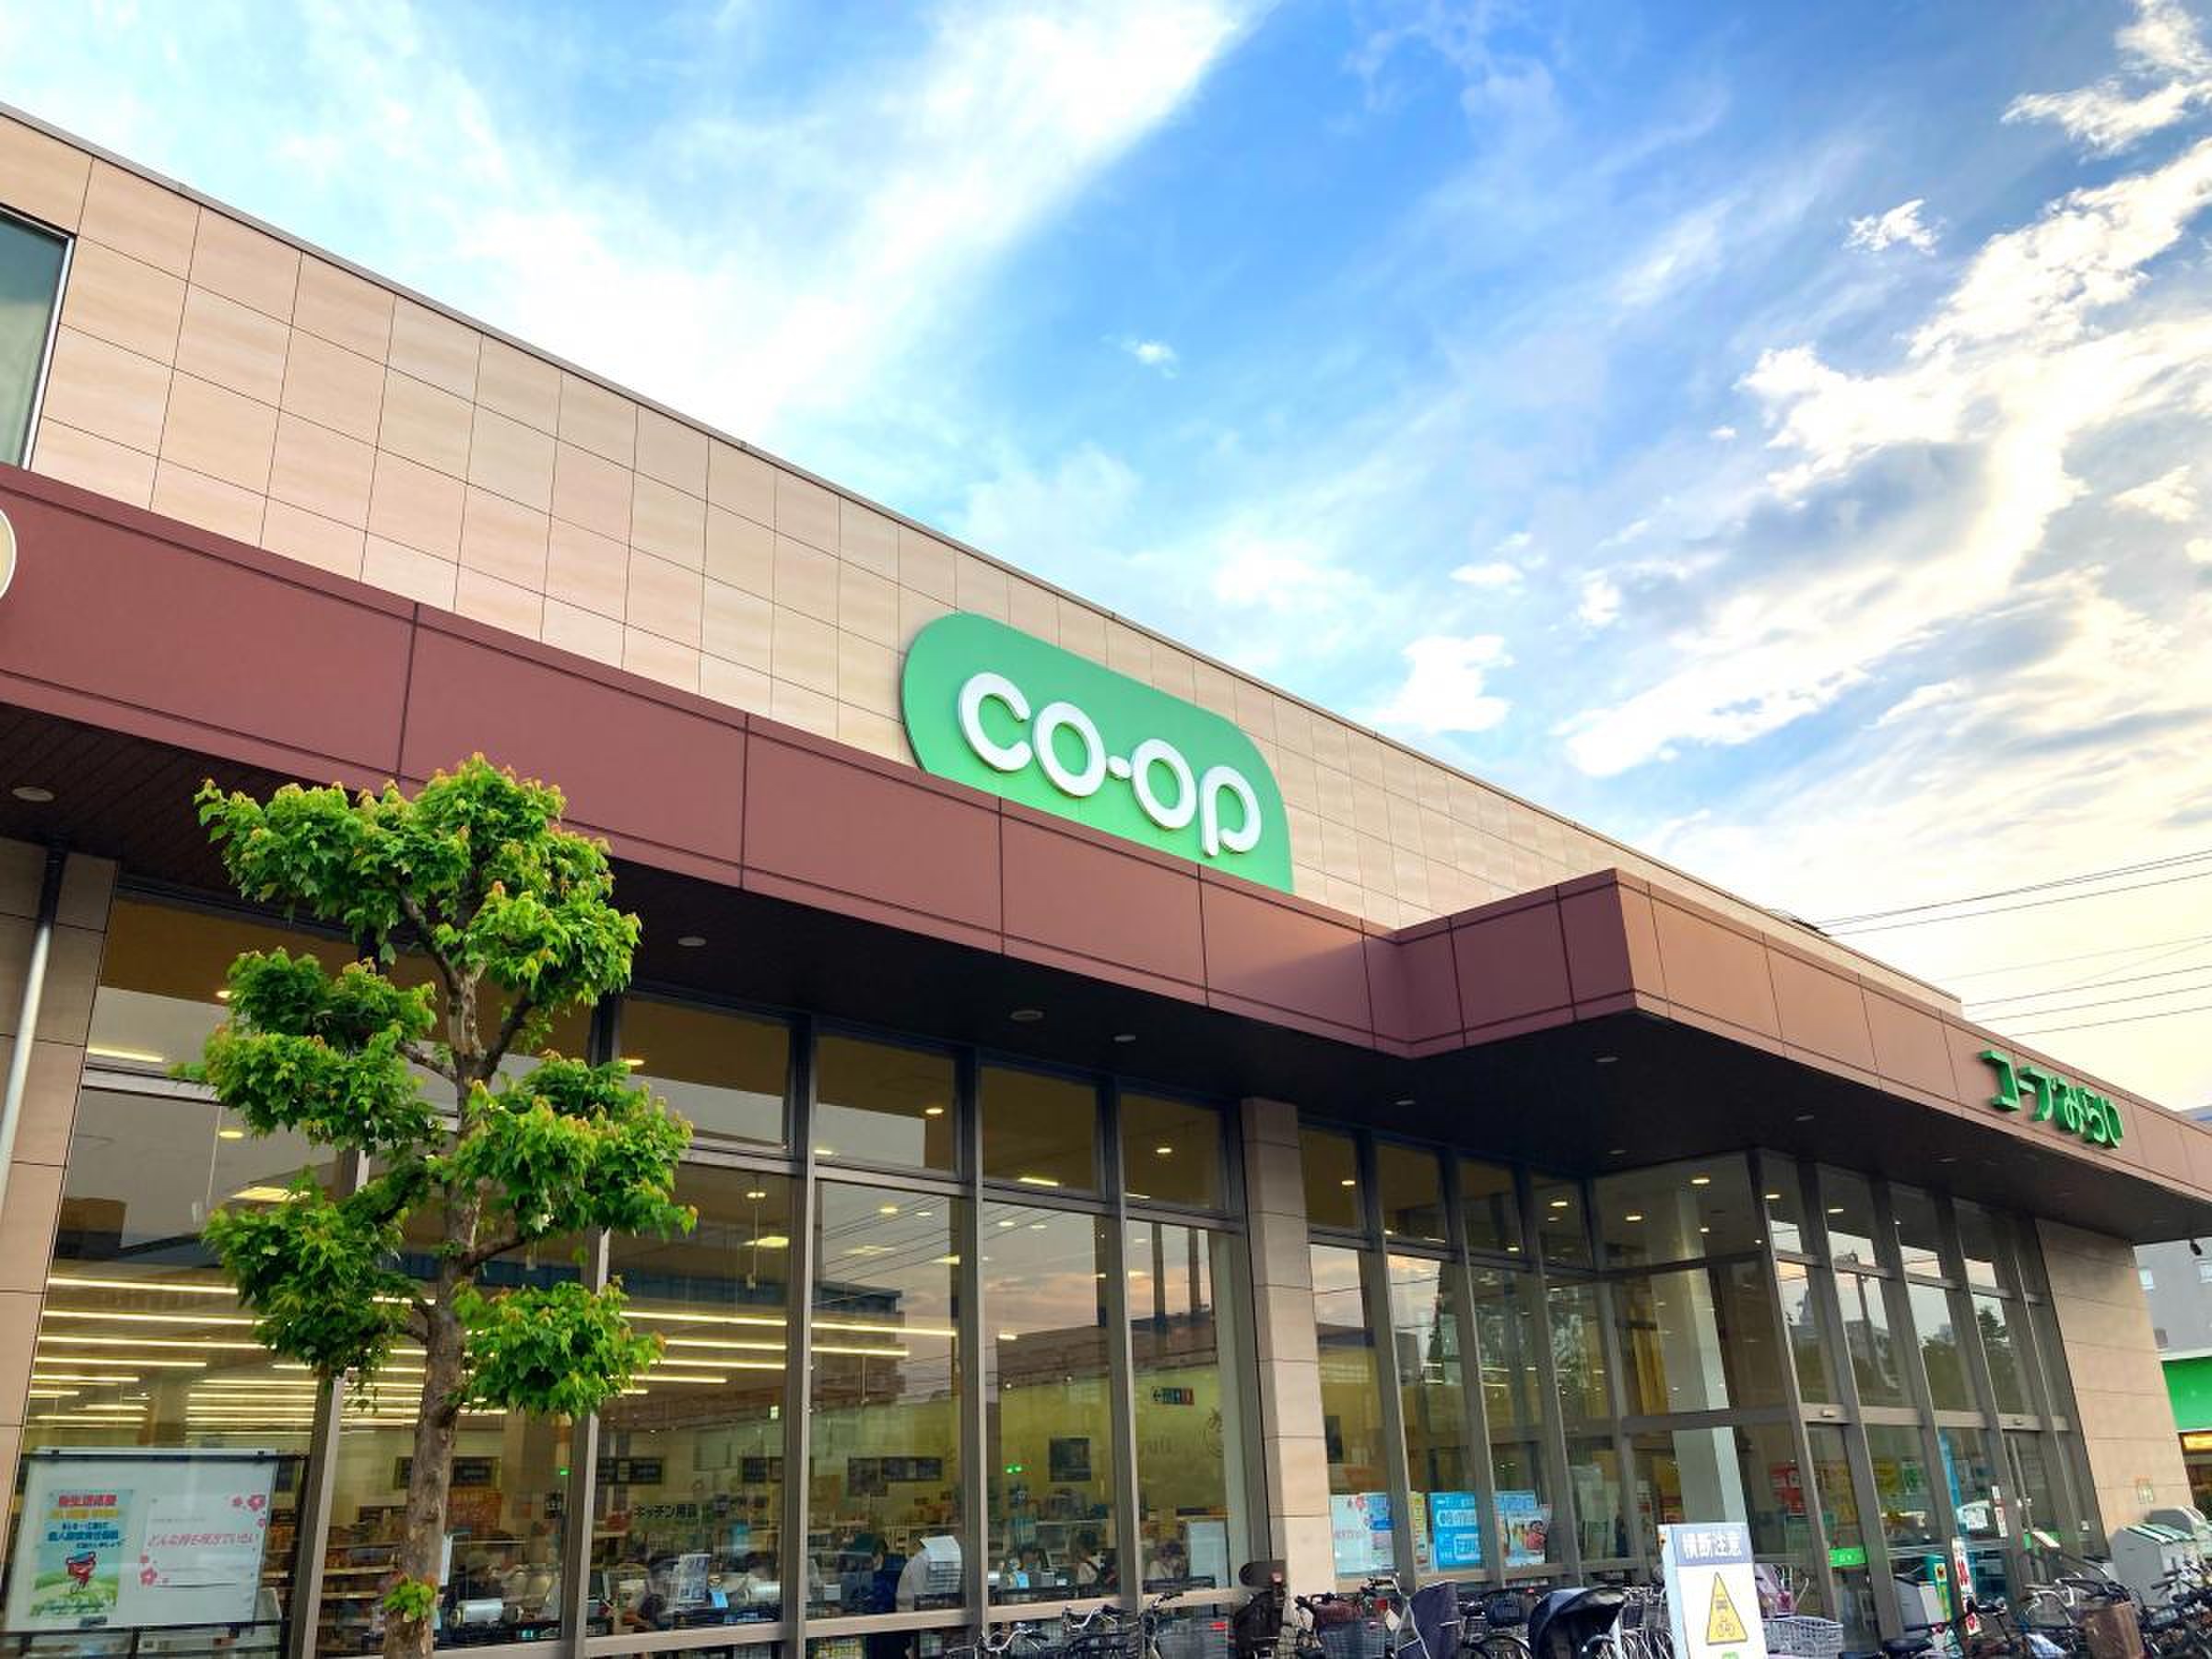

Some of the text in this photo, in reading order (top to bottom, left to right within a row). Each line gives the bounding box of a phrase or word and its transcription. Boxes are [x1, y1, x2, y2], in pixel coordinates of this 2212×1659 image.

[1979, 1050, 2124, 1148] コープみらい
